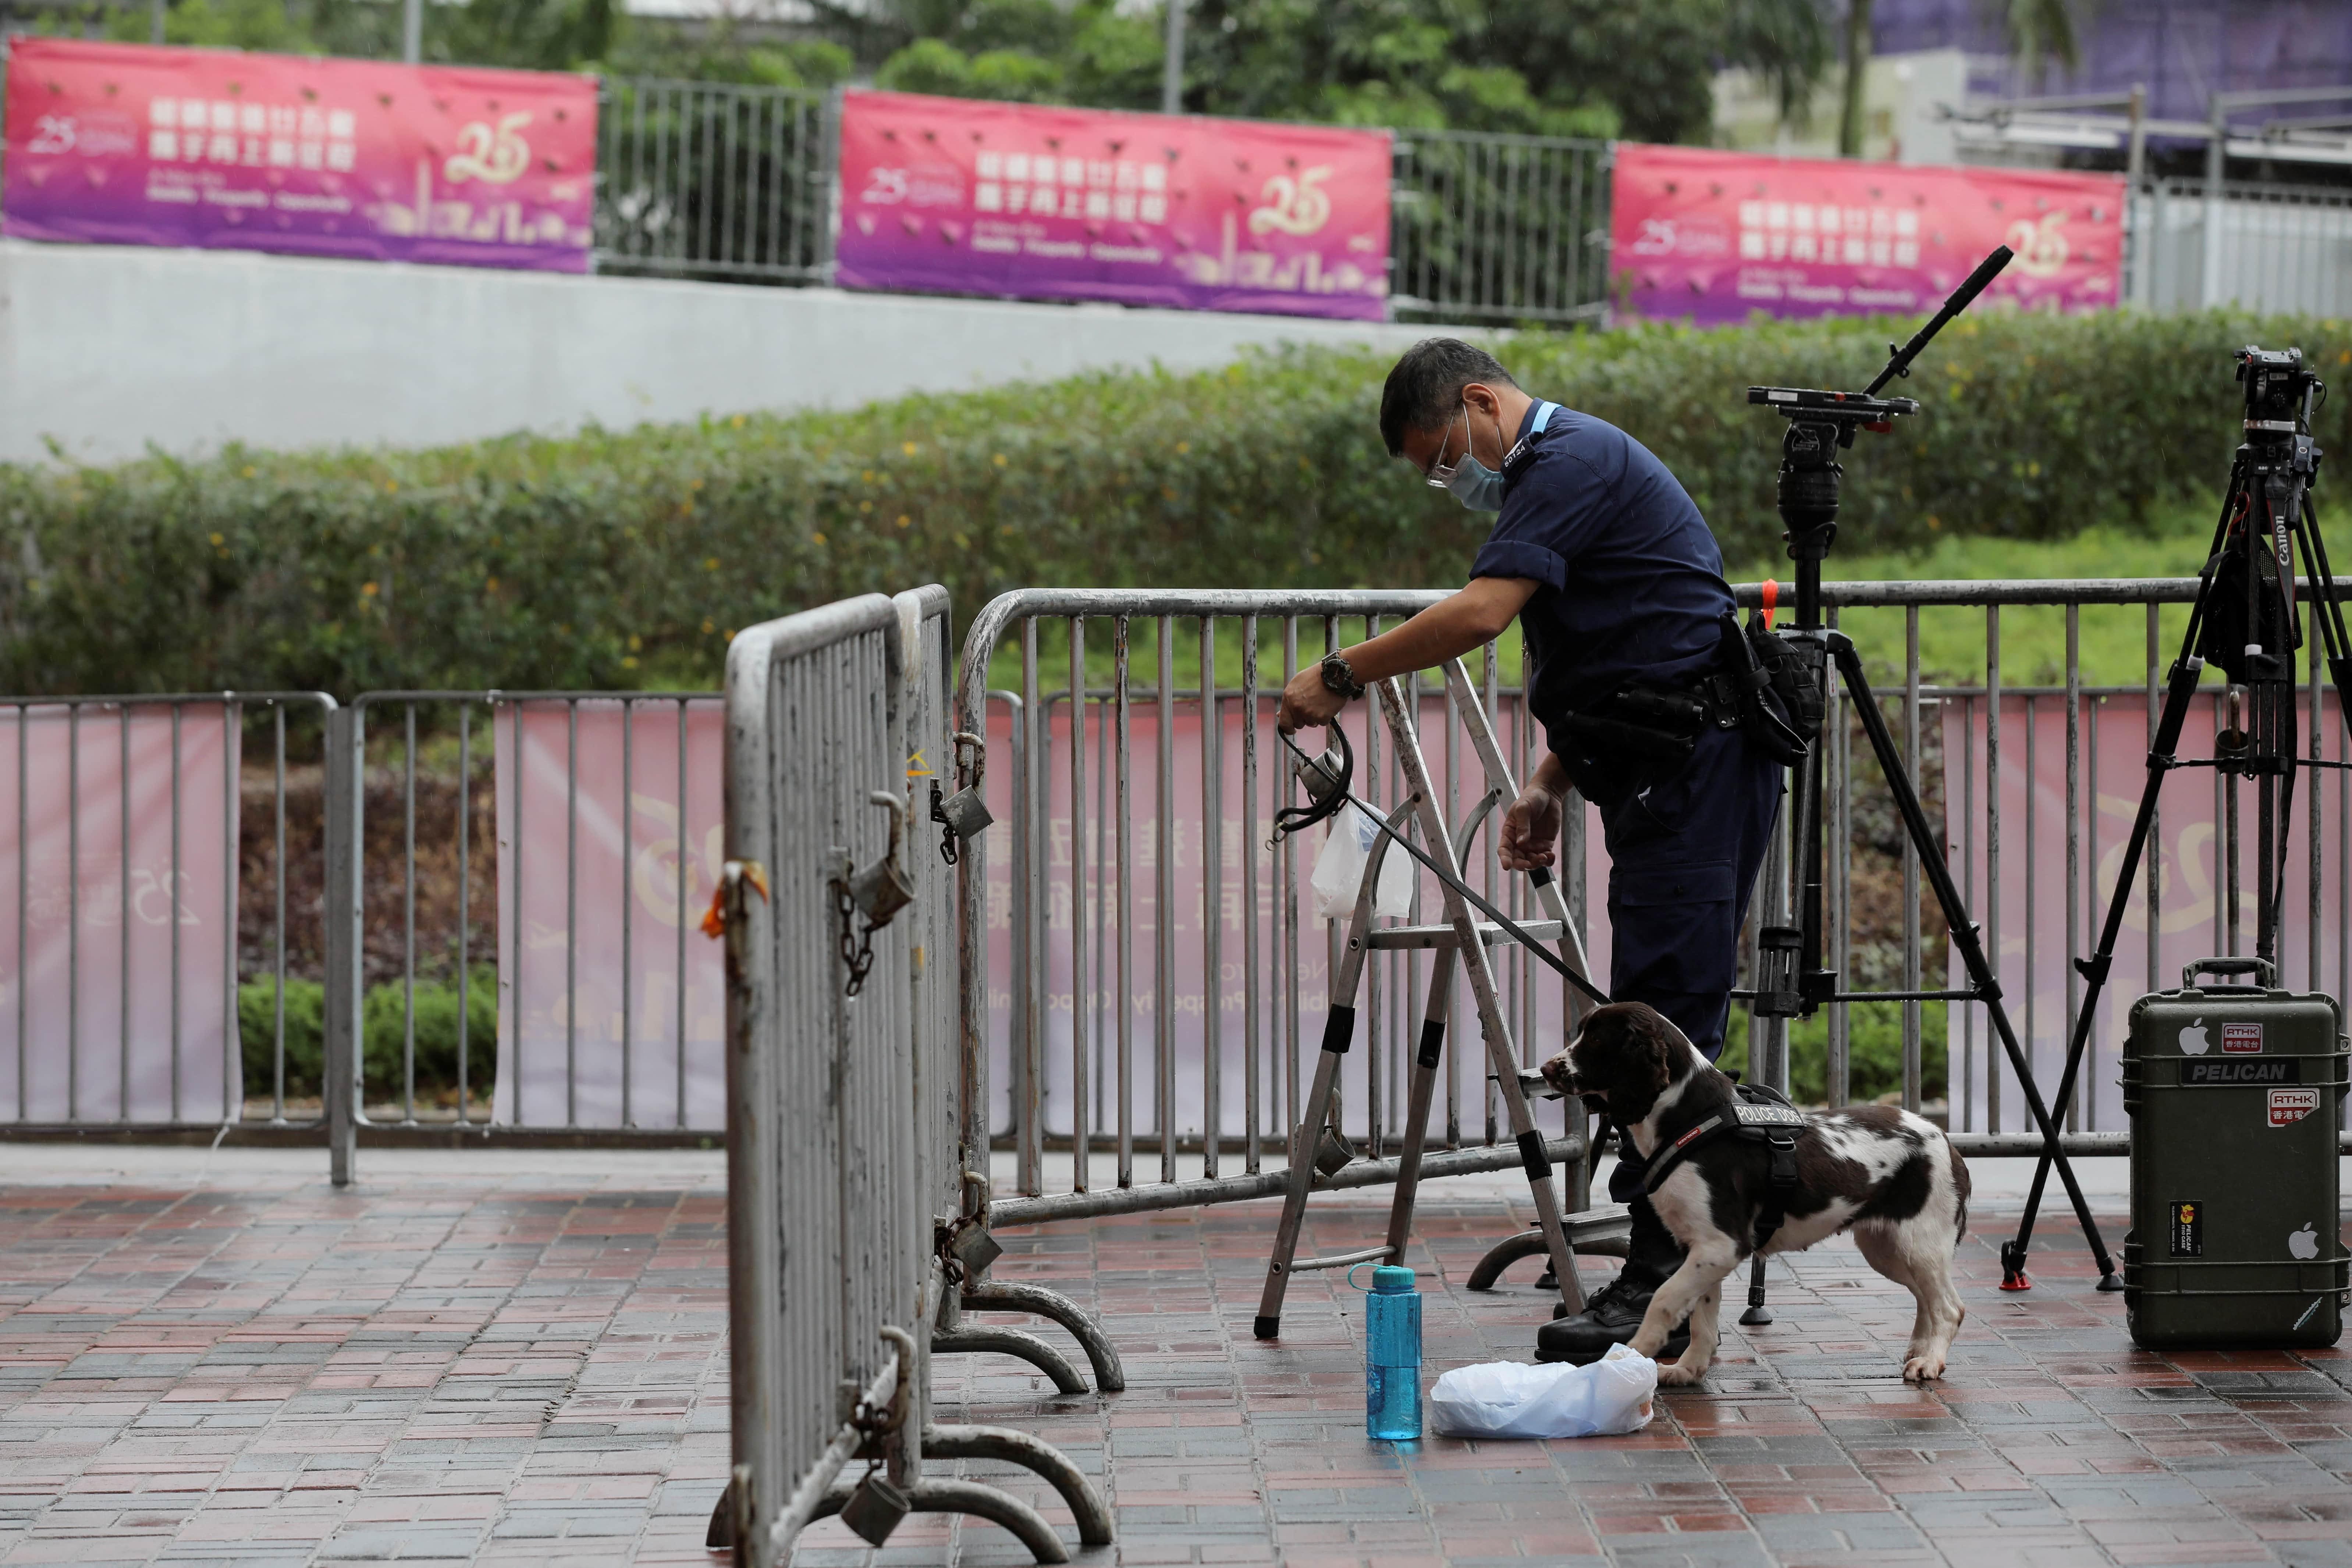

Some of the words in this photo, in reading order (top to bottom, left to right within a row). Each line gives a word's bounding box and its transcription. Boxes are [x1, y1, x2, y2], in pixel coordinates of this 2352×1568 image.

[1504, 445, 1525, 467] 50124
[2275, 515, 2289, 566] Canon
[2192, 1064, 2285, 1080] PELICAN
[1735, 1106, 1778, 1121] POLICE
[1776, 1108, 1802, 1123] DOG
[2273, 1110, 2304, 1120] 香港電
